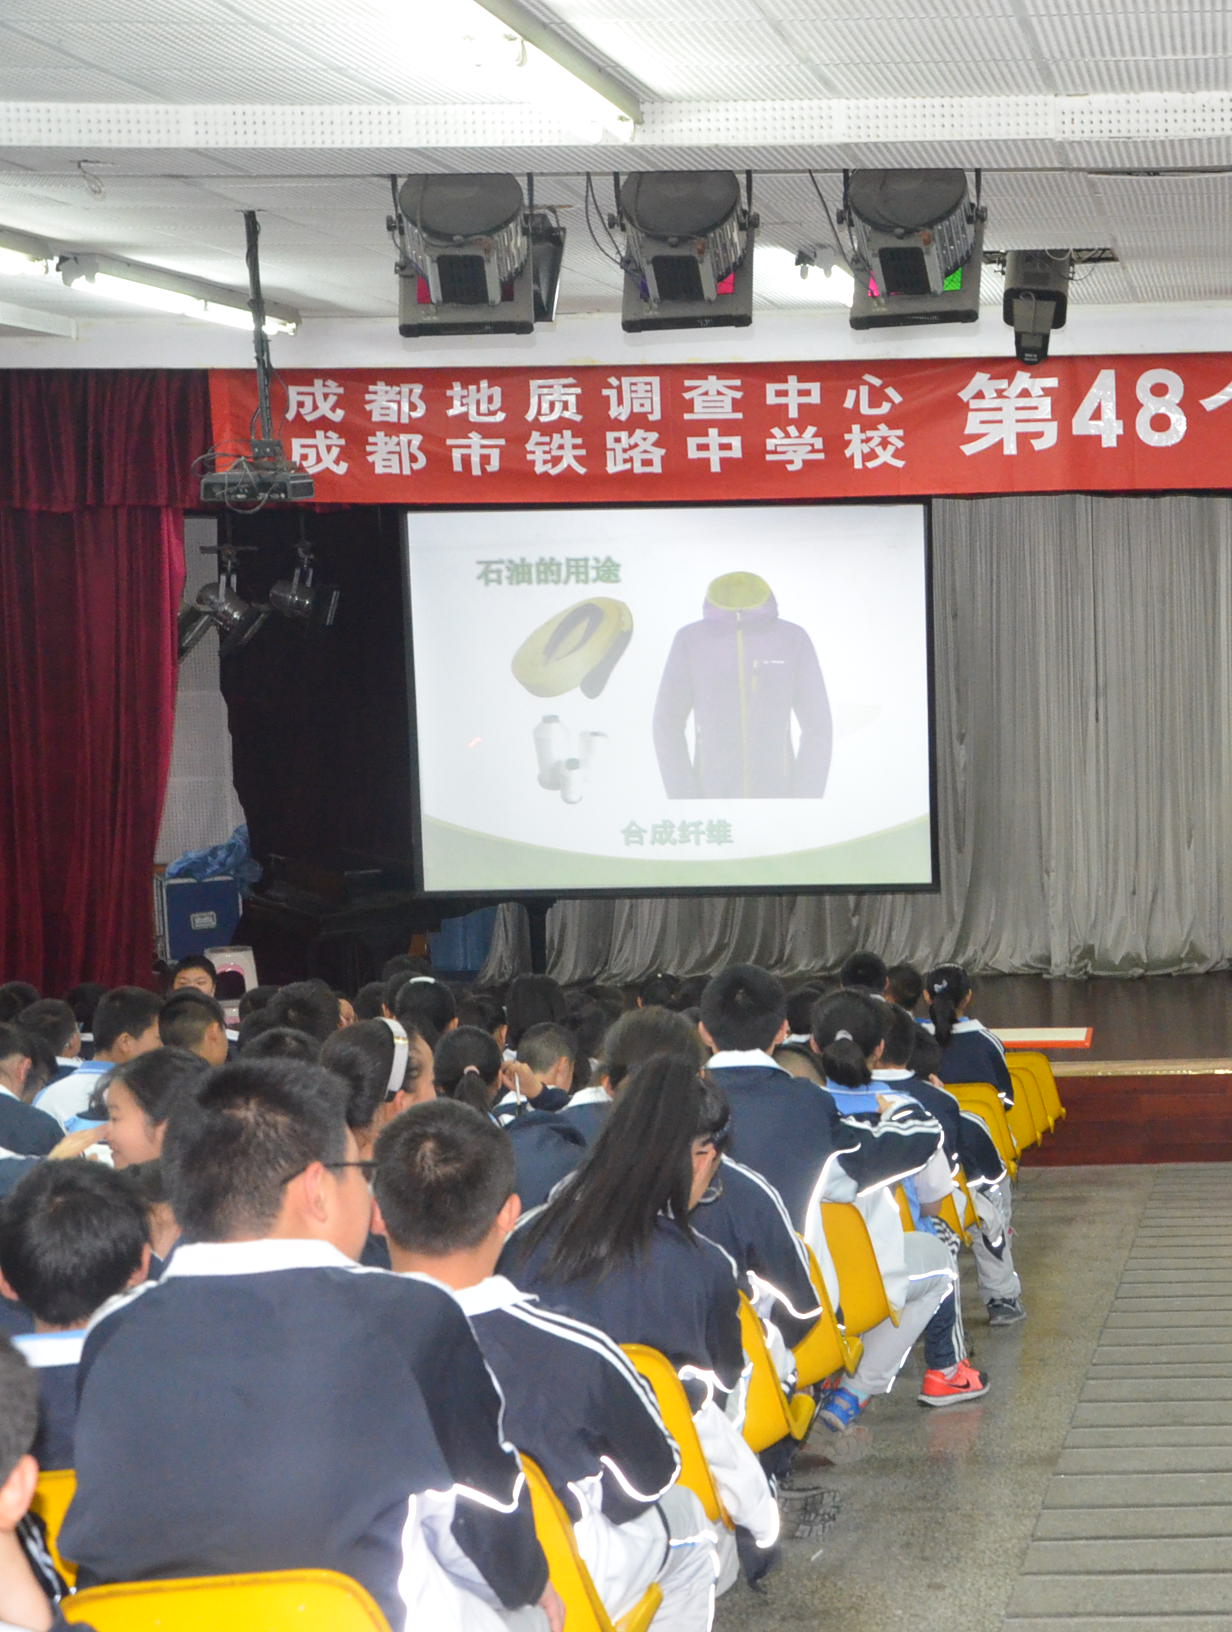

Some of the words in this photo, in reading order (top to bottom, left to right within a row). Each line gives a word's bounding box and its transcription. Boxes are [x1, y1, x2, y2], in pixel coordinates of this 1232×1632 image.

[285, 374, 904, 425] 成都地质调查中心
[291, 424, 906, 476] 成都市铁路中学校
[476, 555, 622, 586] 石油的用途
[620, 818, 735, 847] 合成纤维
